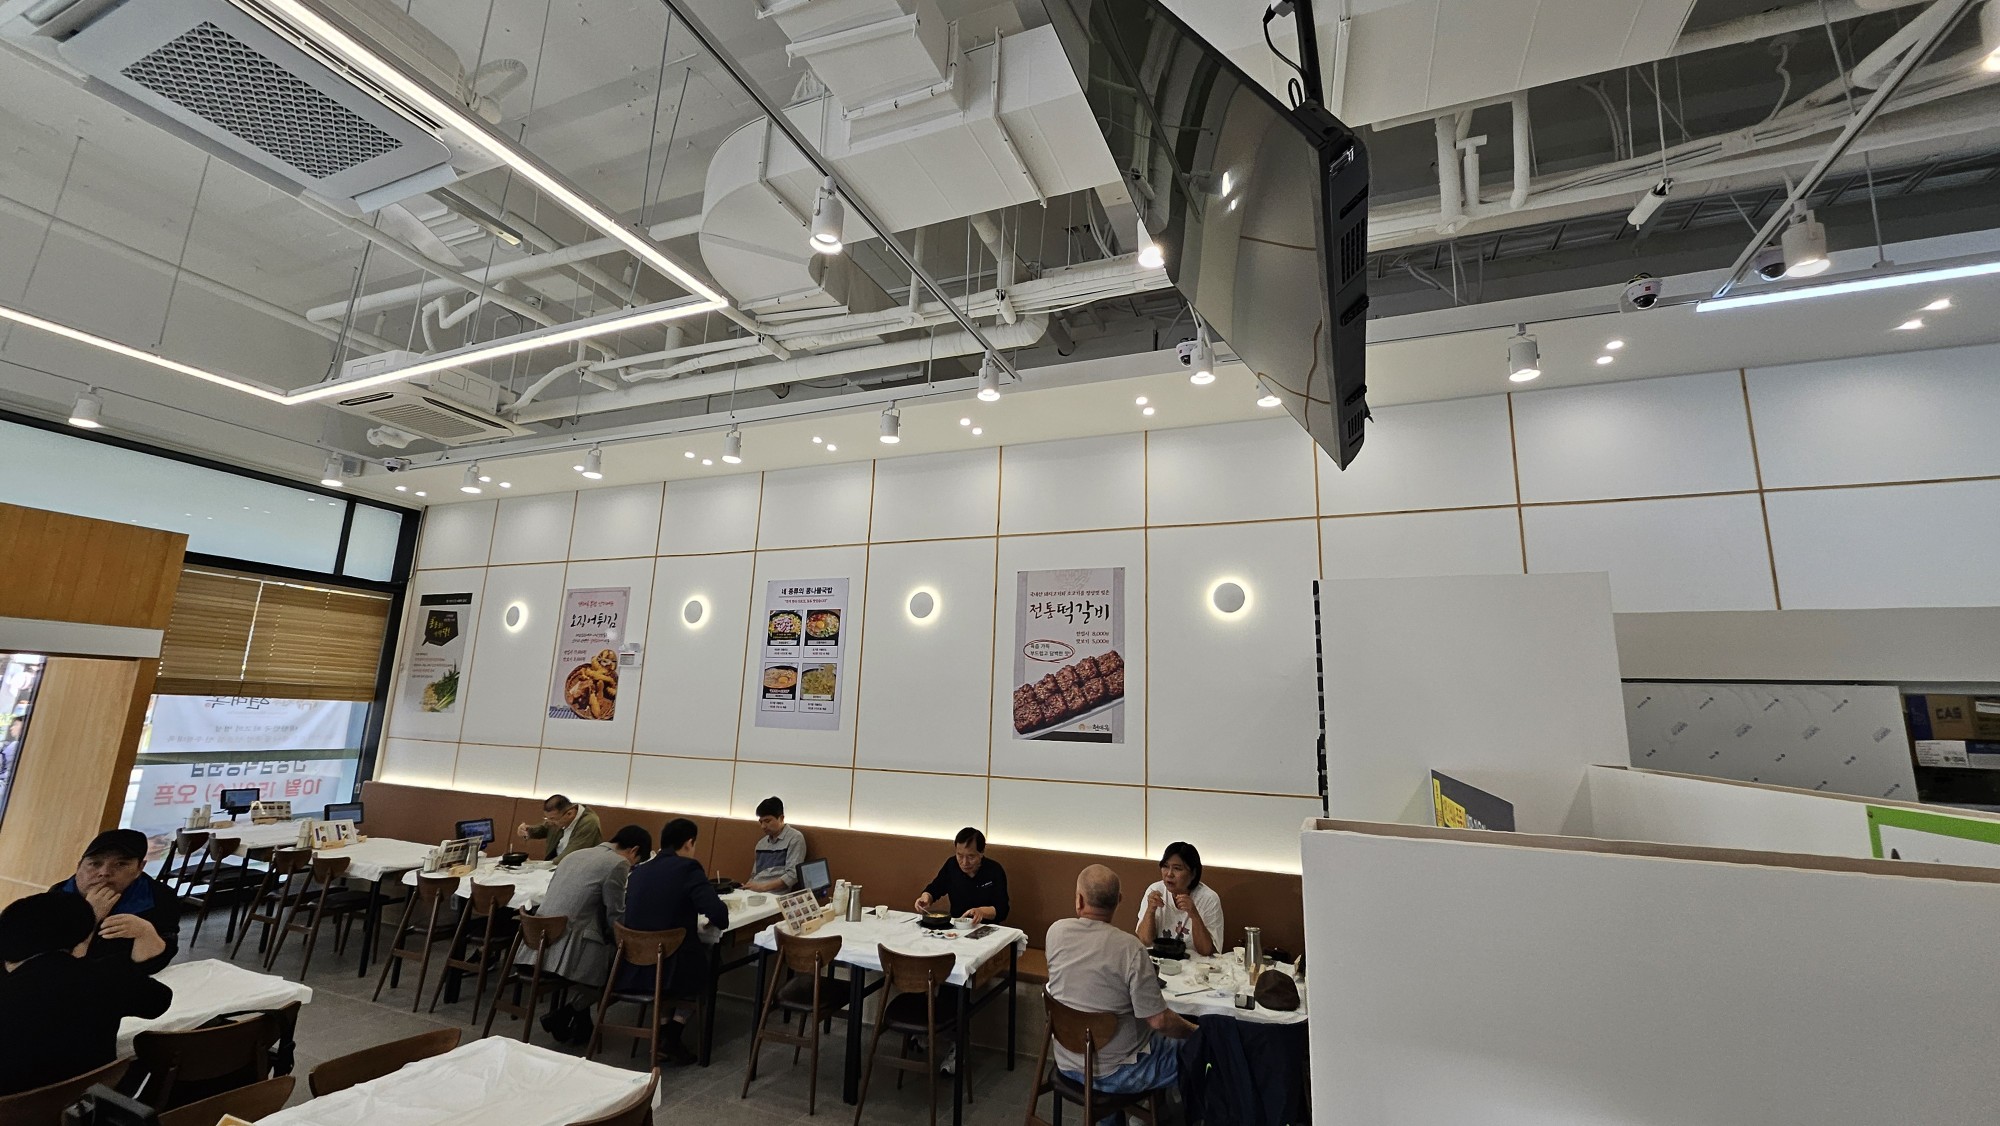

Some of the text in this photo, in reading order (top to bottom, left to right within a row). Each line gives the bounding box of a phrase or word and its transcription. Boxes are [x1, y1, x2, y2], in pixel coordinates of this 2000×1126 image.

[805, 586, 833, 594] 콩나물국밥
[570, 612, 618, 628] 오징어튀김
[1936, 707, 1962, 720] CAS
